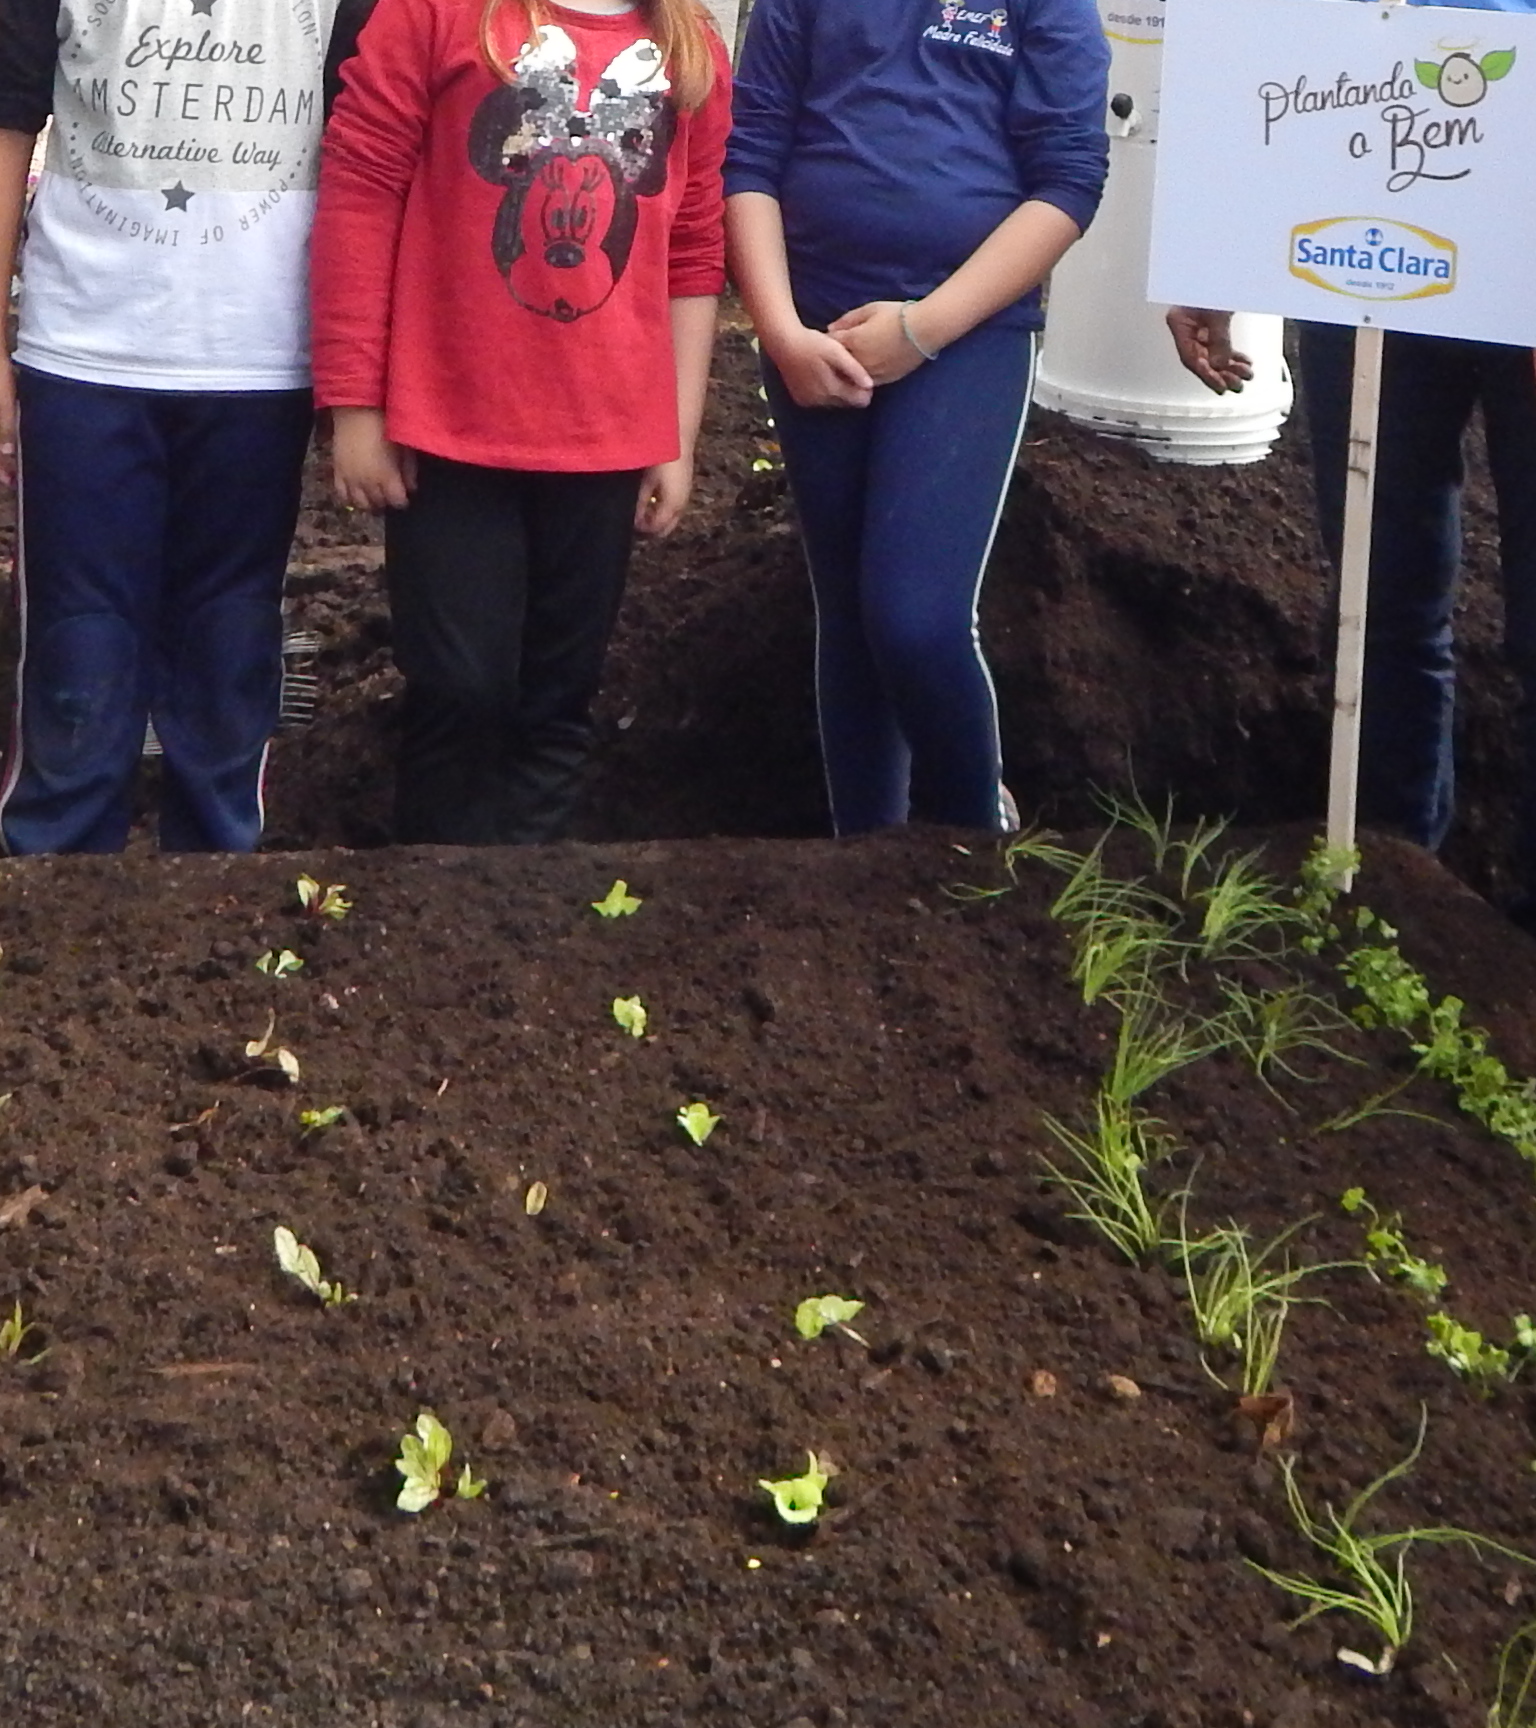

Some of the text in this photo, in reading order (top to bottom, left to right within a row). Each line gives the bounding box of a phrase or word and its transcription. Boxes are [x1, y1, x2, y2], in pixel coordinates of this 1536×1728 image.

[1107, 12, 1165, 28] desde 191
[125, 25, 267, 70] Explore
[72, 77, 314, 125] AMSTERDAM
[1258, 61, 1418, 146] Plantando
[232, 141, 283, 171] Way
[1380, 104, 1485, 193] Bem
[1297, 238, 1451, 279] Santa Clara
